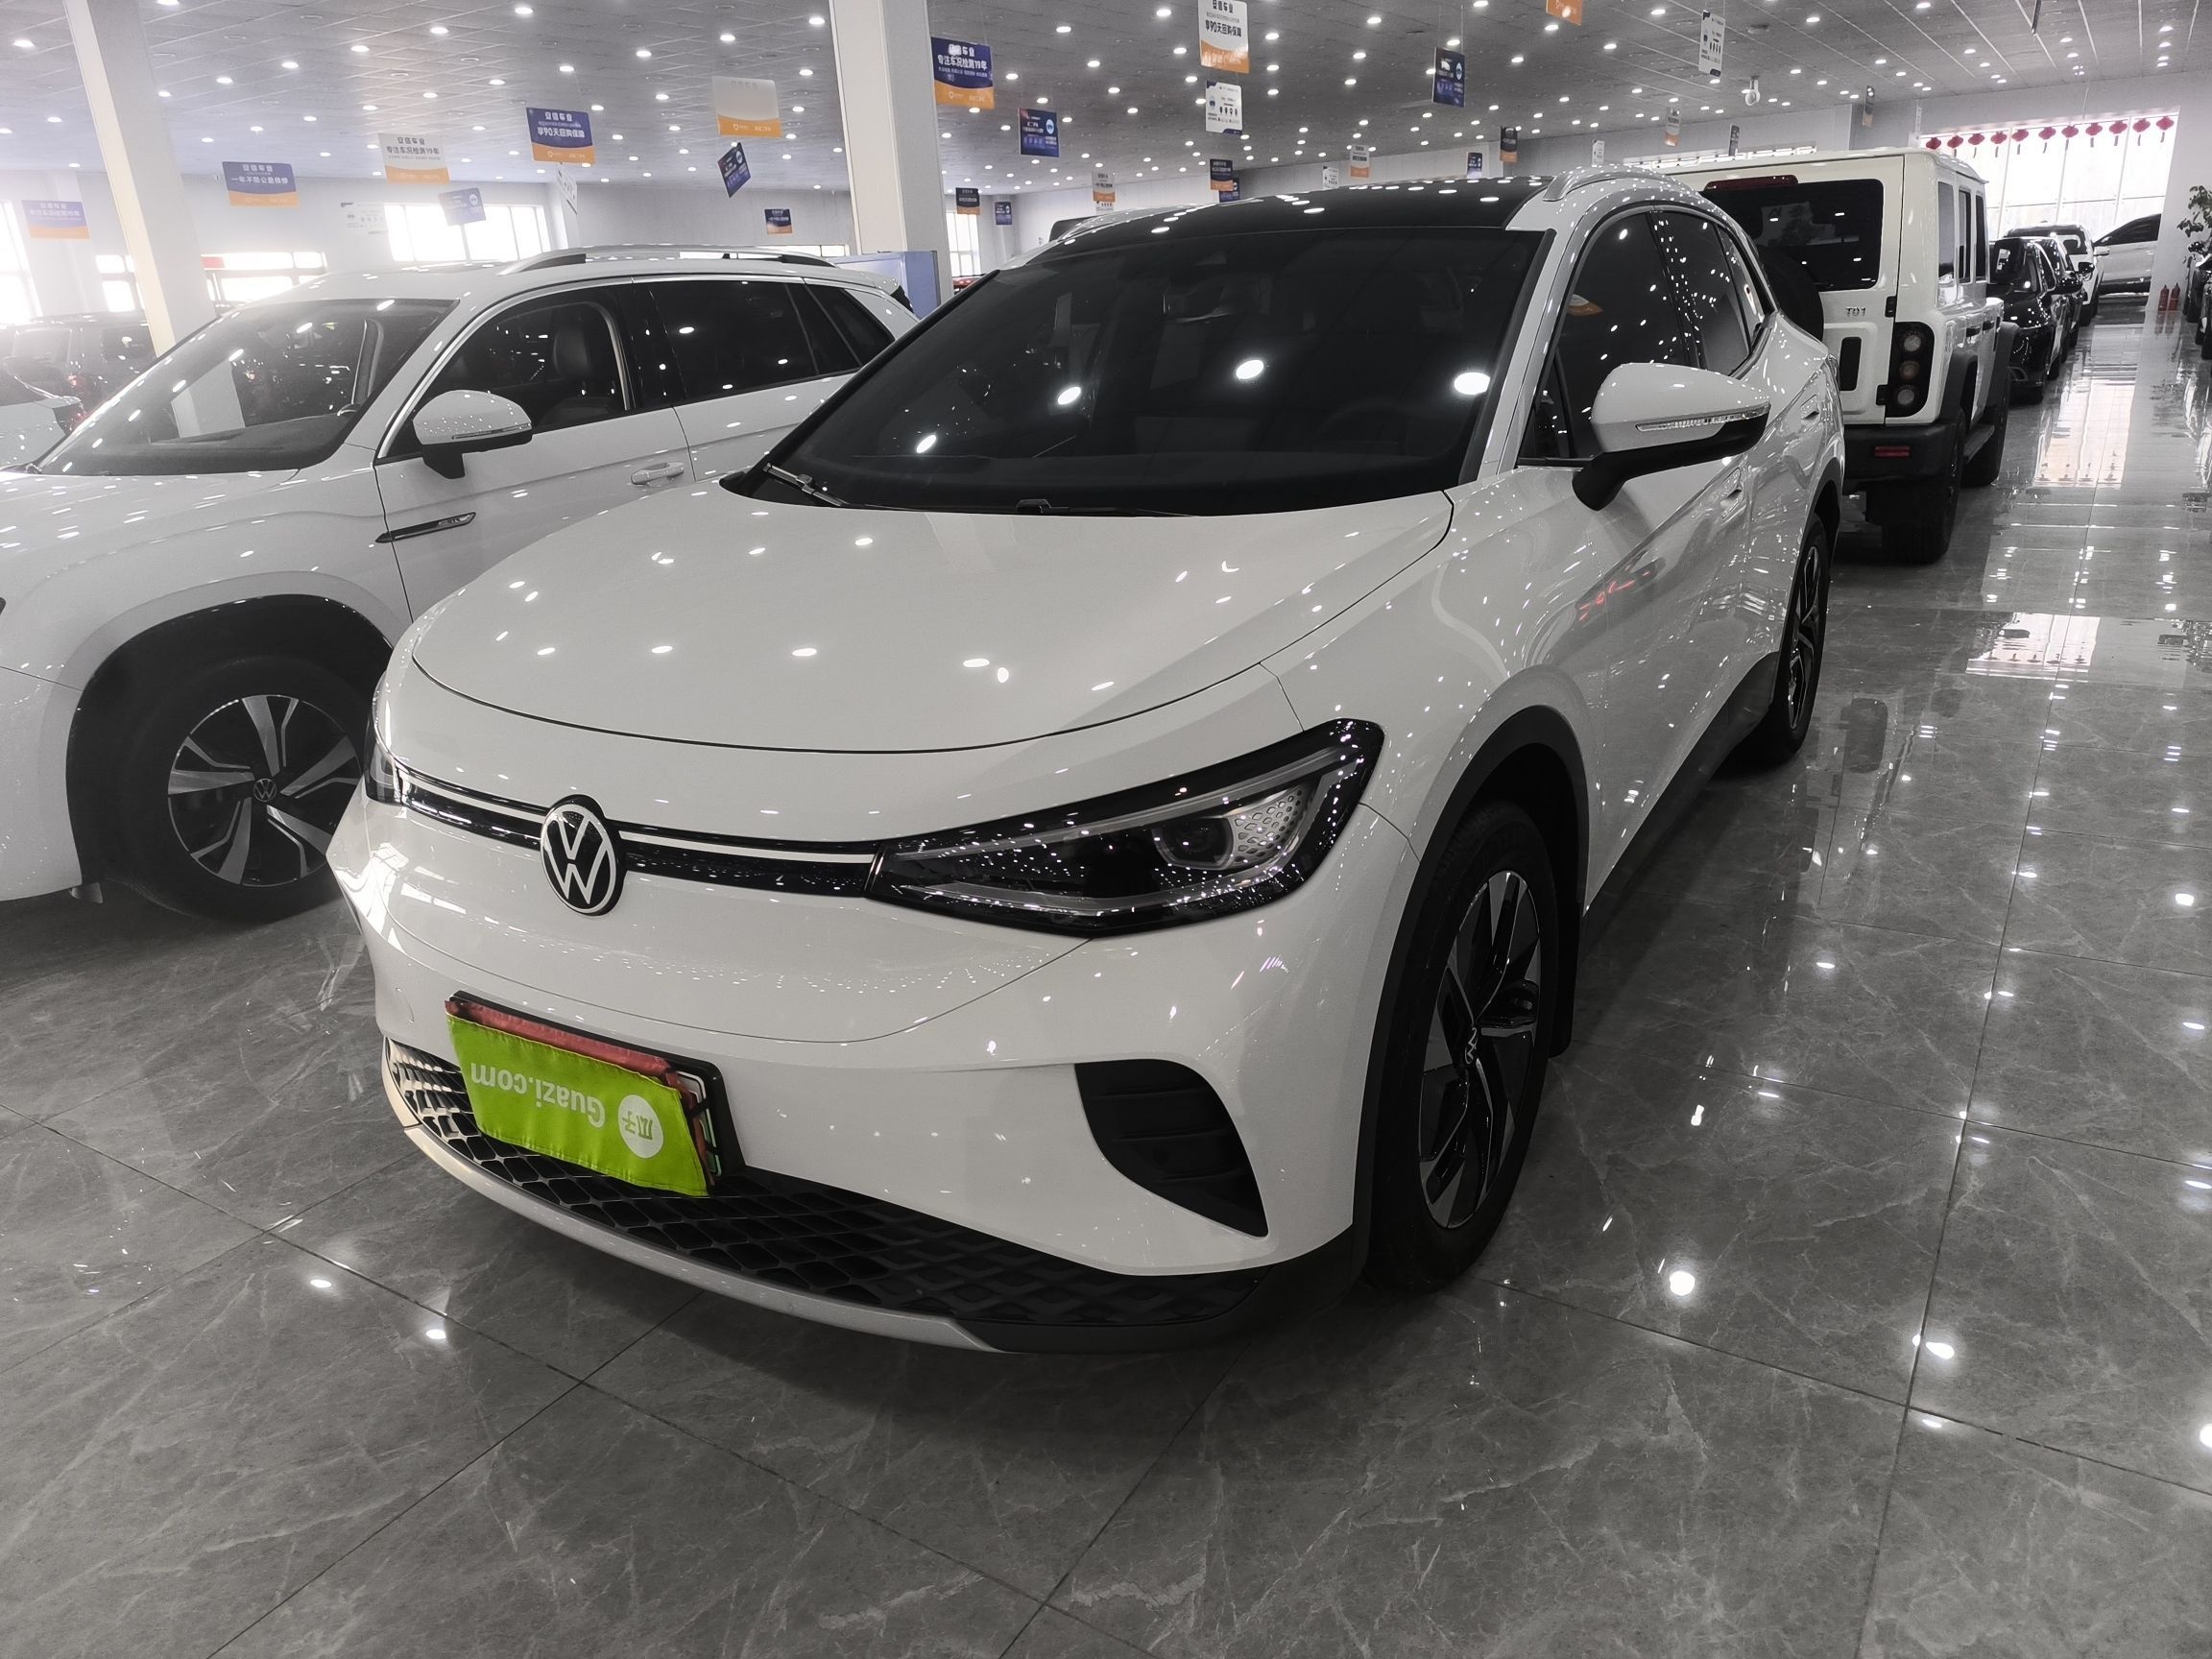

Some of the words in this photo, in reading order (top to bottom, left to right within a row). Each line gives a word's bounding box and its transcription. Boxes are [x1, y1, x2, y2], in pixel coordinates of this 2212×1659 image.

[543, 806, 614, 912] VW
[470, 1063, 606, 1128] Guazi.com
[622, 1110, 654, 1141] 瓜子
